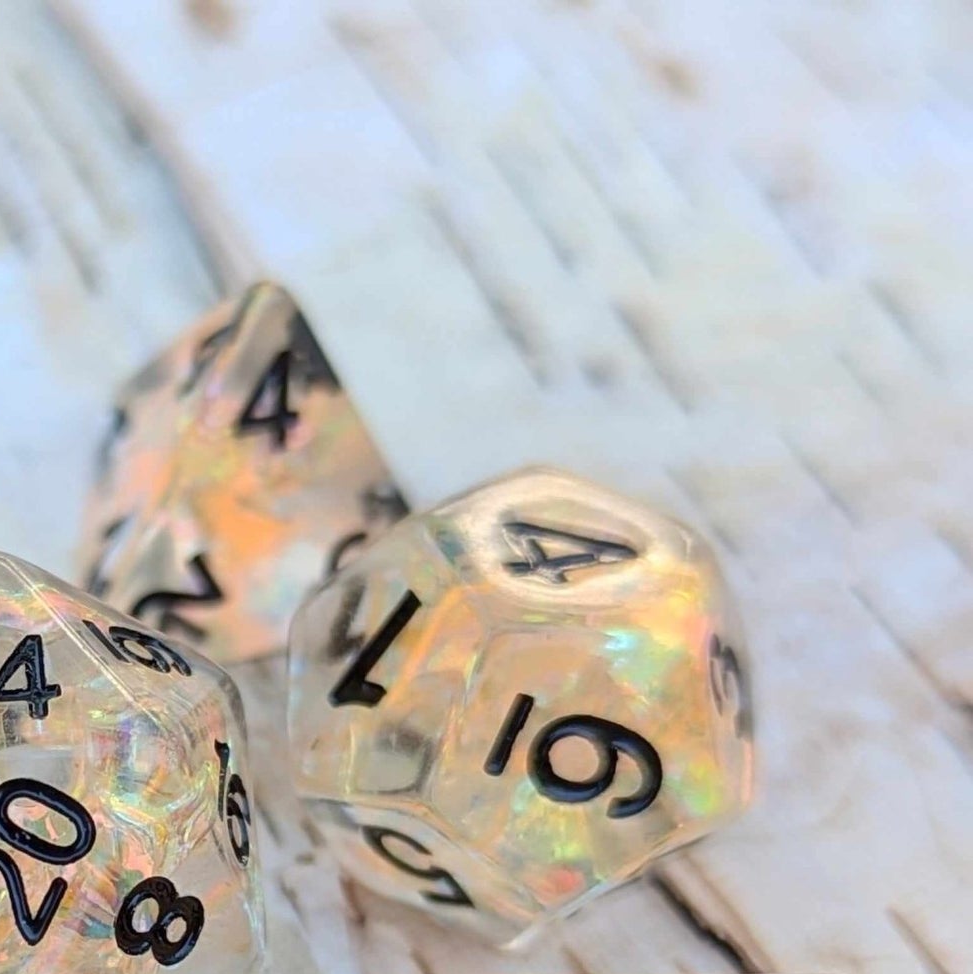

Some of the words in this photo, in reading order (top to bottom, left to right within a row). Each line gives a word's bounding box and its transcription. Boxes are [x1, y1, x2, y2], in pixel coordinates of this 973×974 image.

[238, 350, 299, 450] 4
[502, 521, 639, 584] 4
[362, 825, 475, 908] 5
[114, 877, 204, 966] 8
